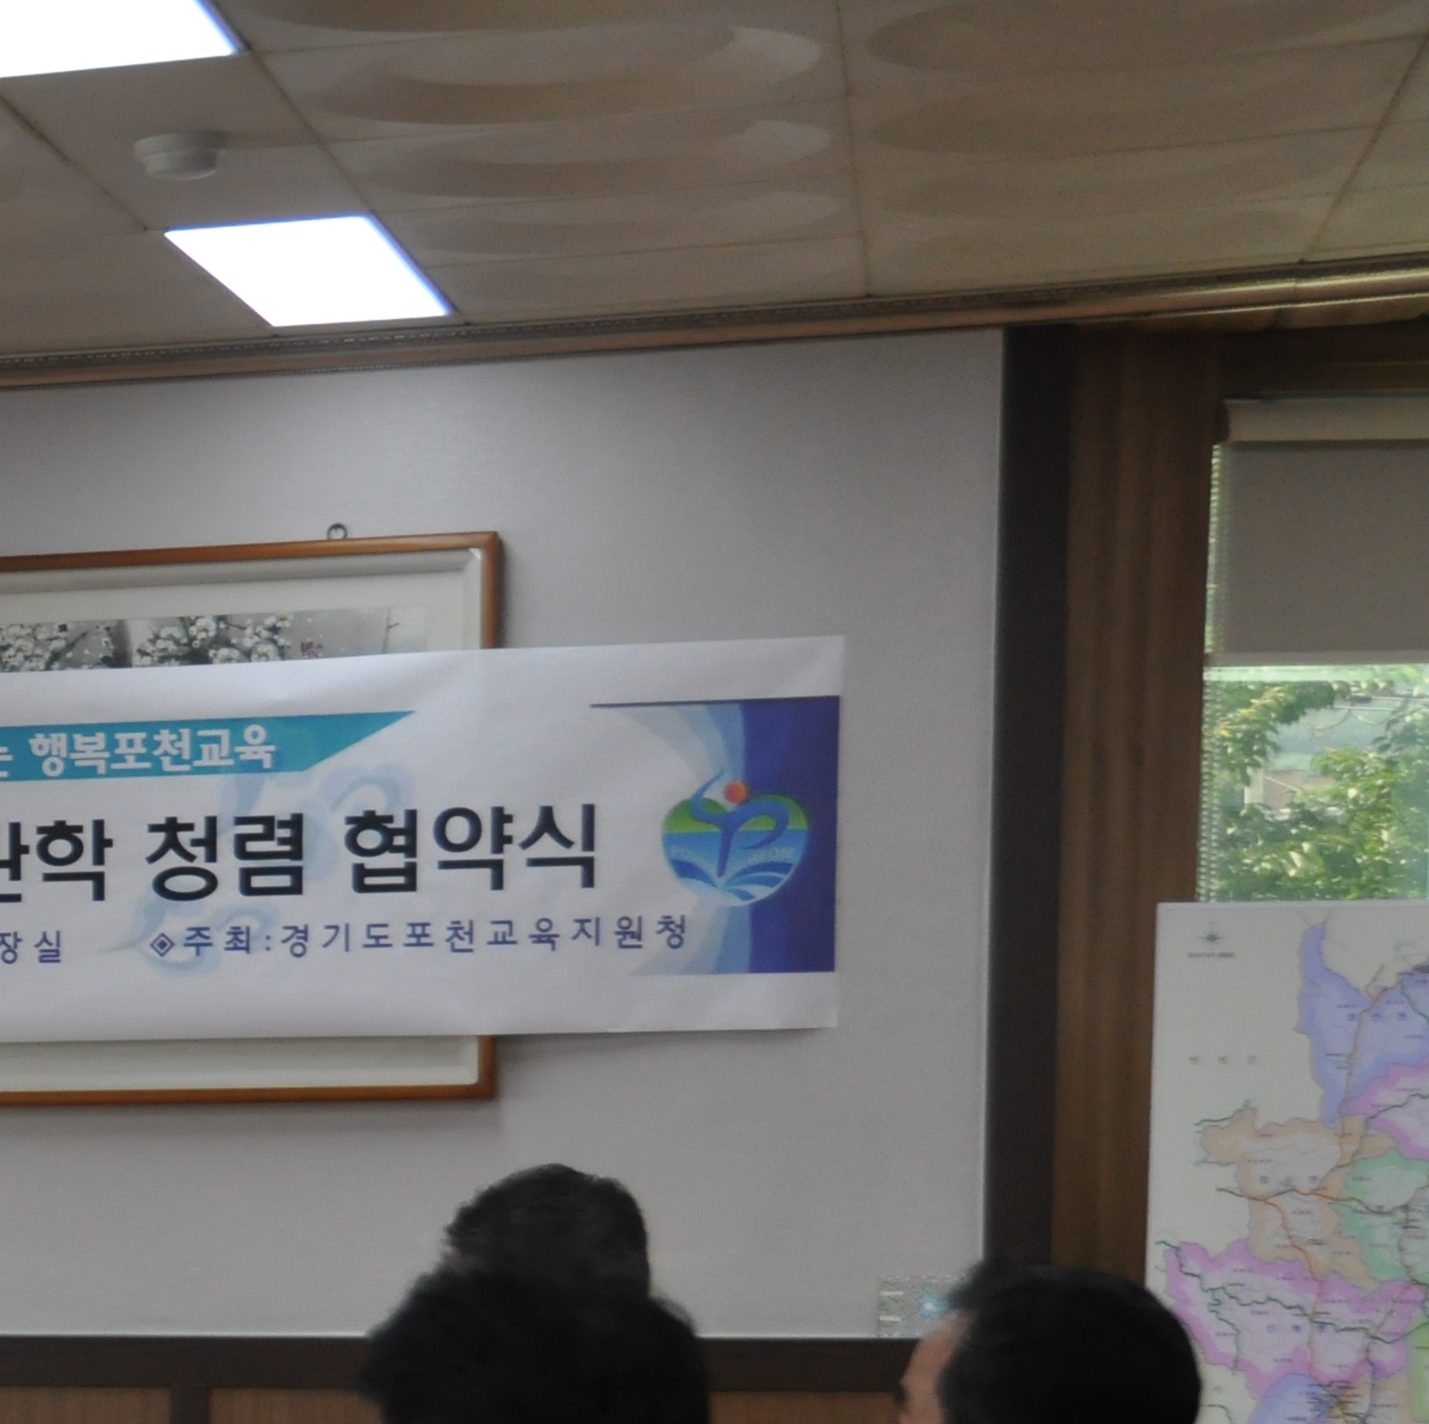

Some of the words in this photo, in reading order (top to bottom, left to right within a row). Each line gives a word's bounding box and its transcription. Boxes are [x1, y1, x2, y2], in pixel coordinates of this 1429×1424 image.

[28, 724, 277, 778] 행복포천교육
[145, 812, 304, 902] 청렴
[344, 803, 596, 894] 협약식
